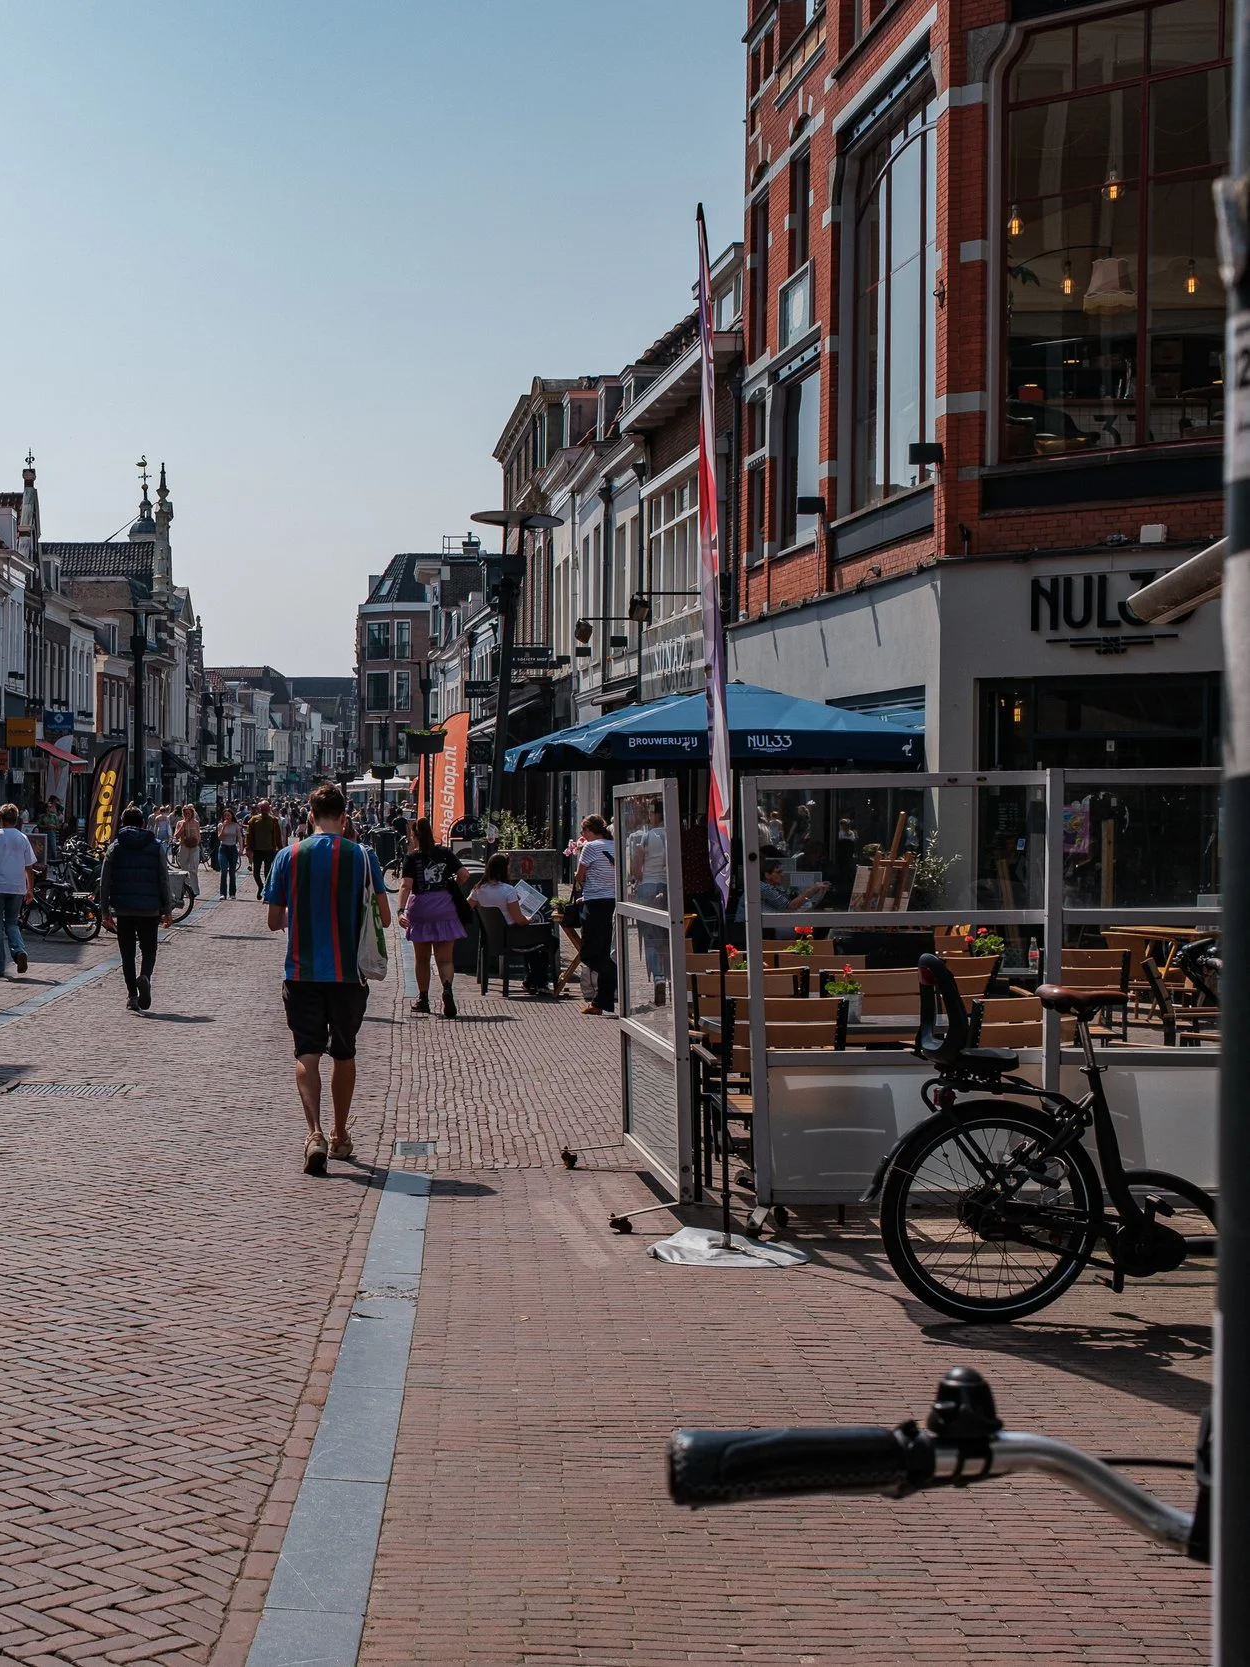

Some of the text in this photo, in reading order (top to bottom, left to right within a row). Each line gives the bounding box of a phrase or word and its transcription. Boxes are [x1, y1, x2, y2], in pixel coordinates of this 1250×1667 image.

[1031, 568, 1197, 632] NUL3
[628, 737, 681, 748] BROUWERIJ
[747, 735, 793, 748] NUL33
